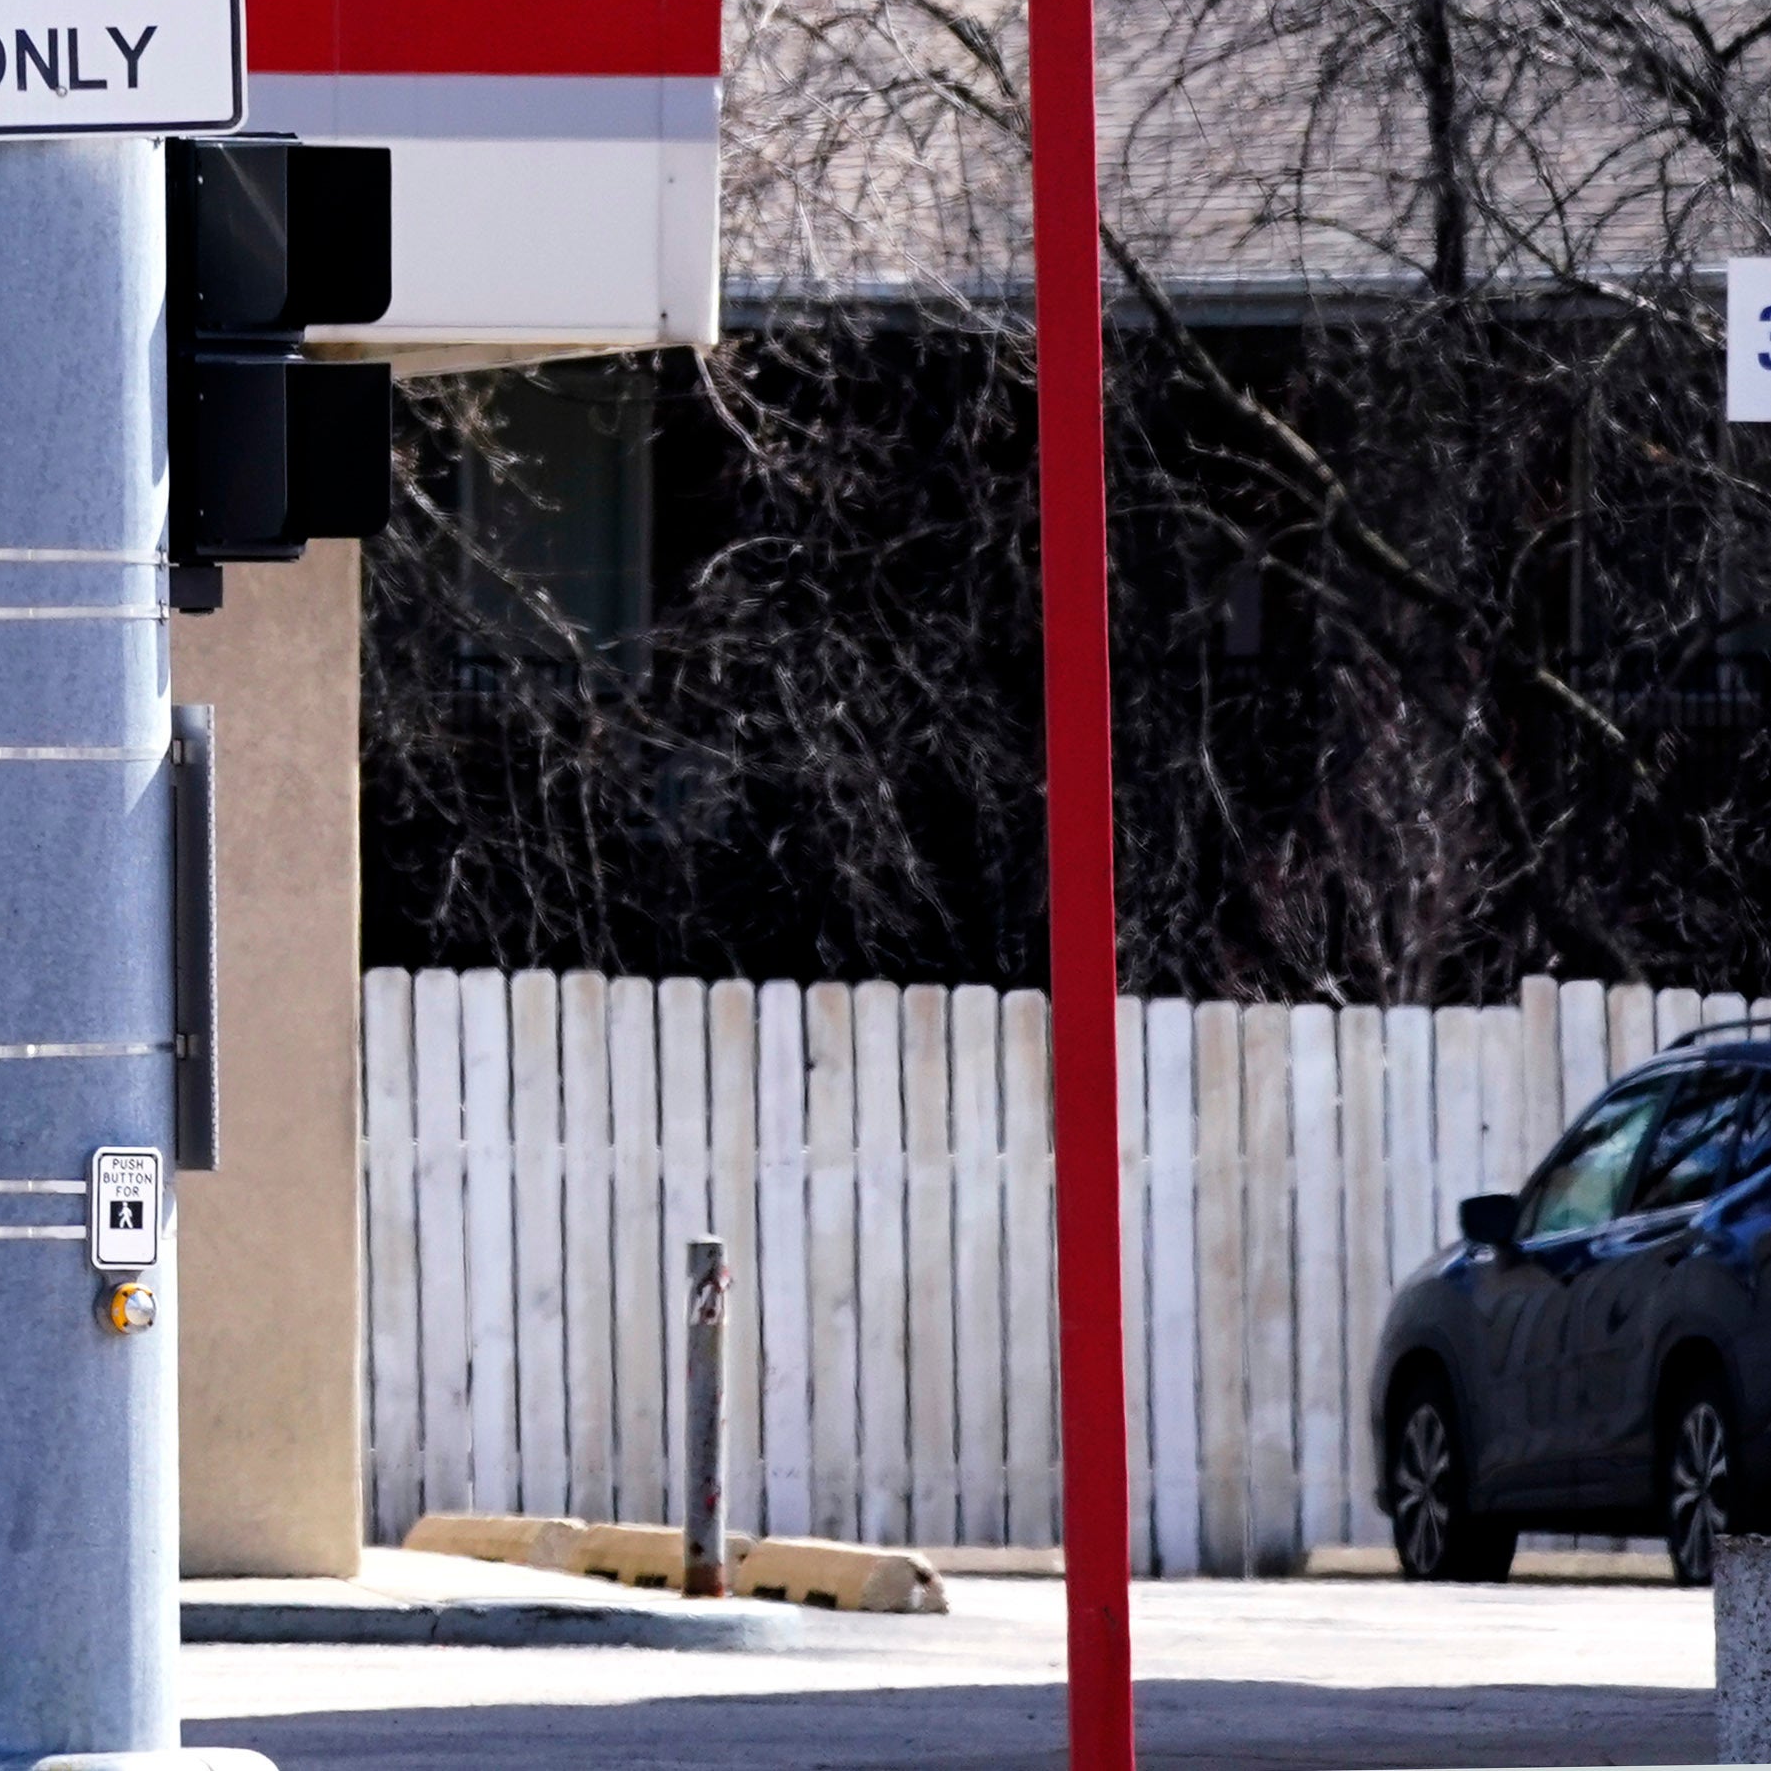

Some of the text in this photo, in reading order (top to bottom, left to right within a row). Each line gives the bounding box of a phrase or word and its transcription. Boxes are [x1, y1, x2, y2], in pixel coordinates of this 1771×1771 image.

[112, 1158, 145, 1171] PUSH
[103, 1171, 153, 1185] BUTTON
[116, 1185, 140, 1198] FOR
